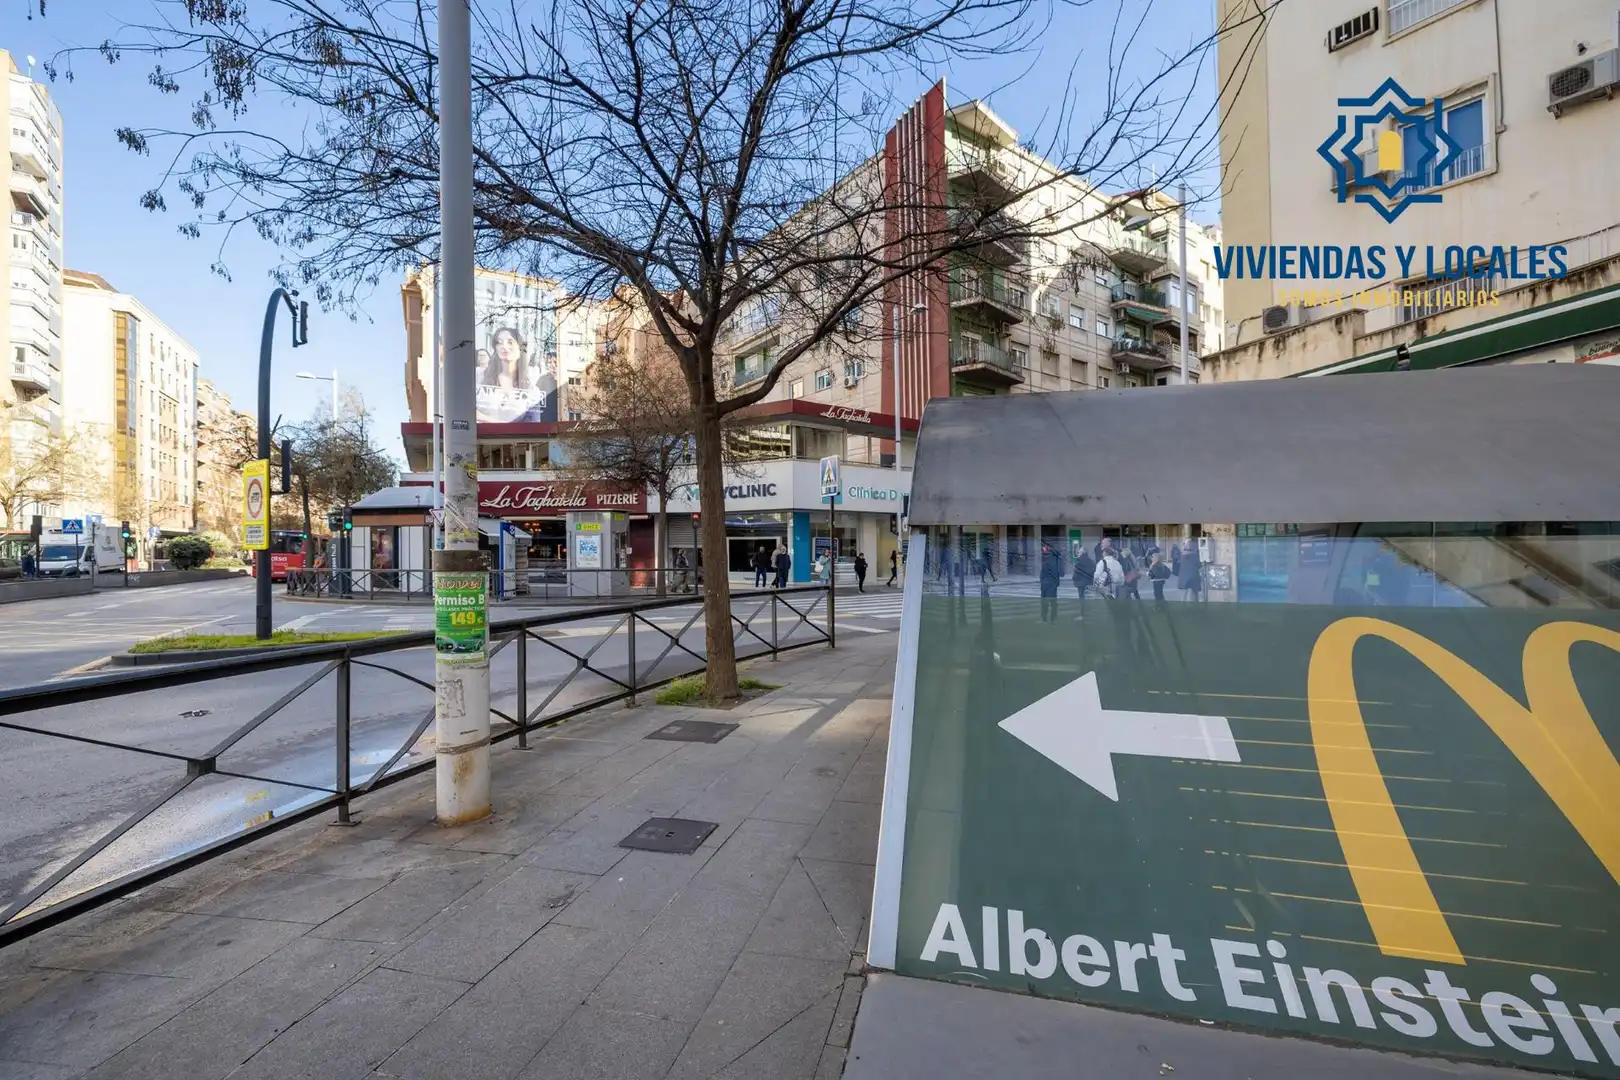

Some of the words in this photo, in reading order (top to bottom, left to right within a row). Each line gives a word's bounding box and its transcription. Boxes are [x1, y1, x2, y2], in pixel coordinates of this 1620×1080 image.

[480, 485, 511, 508] La
[511, 483, 587, 512] Tagliatella
[596, 493, 639, 505] PIZZERIE
[848, 486, 886, 500] Clínica
[450, 611, 476, 625] 149
[920, 902, 1198, 1002] Albert
